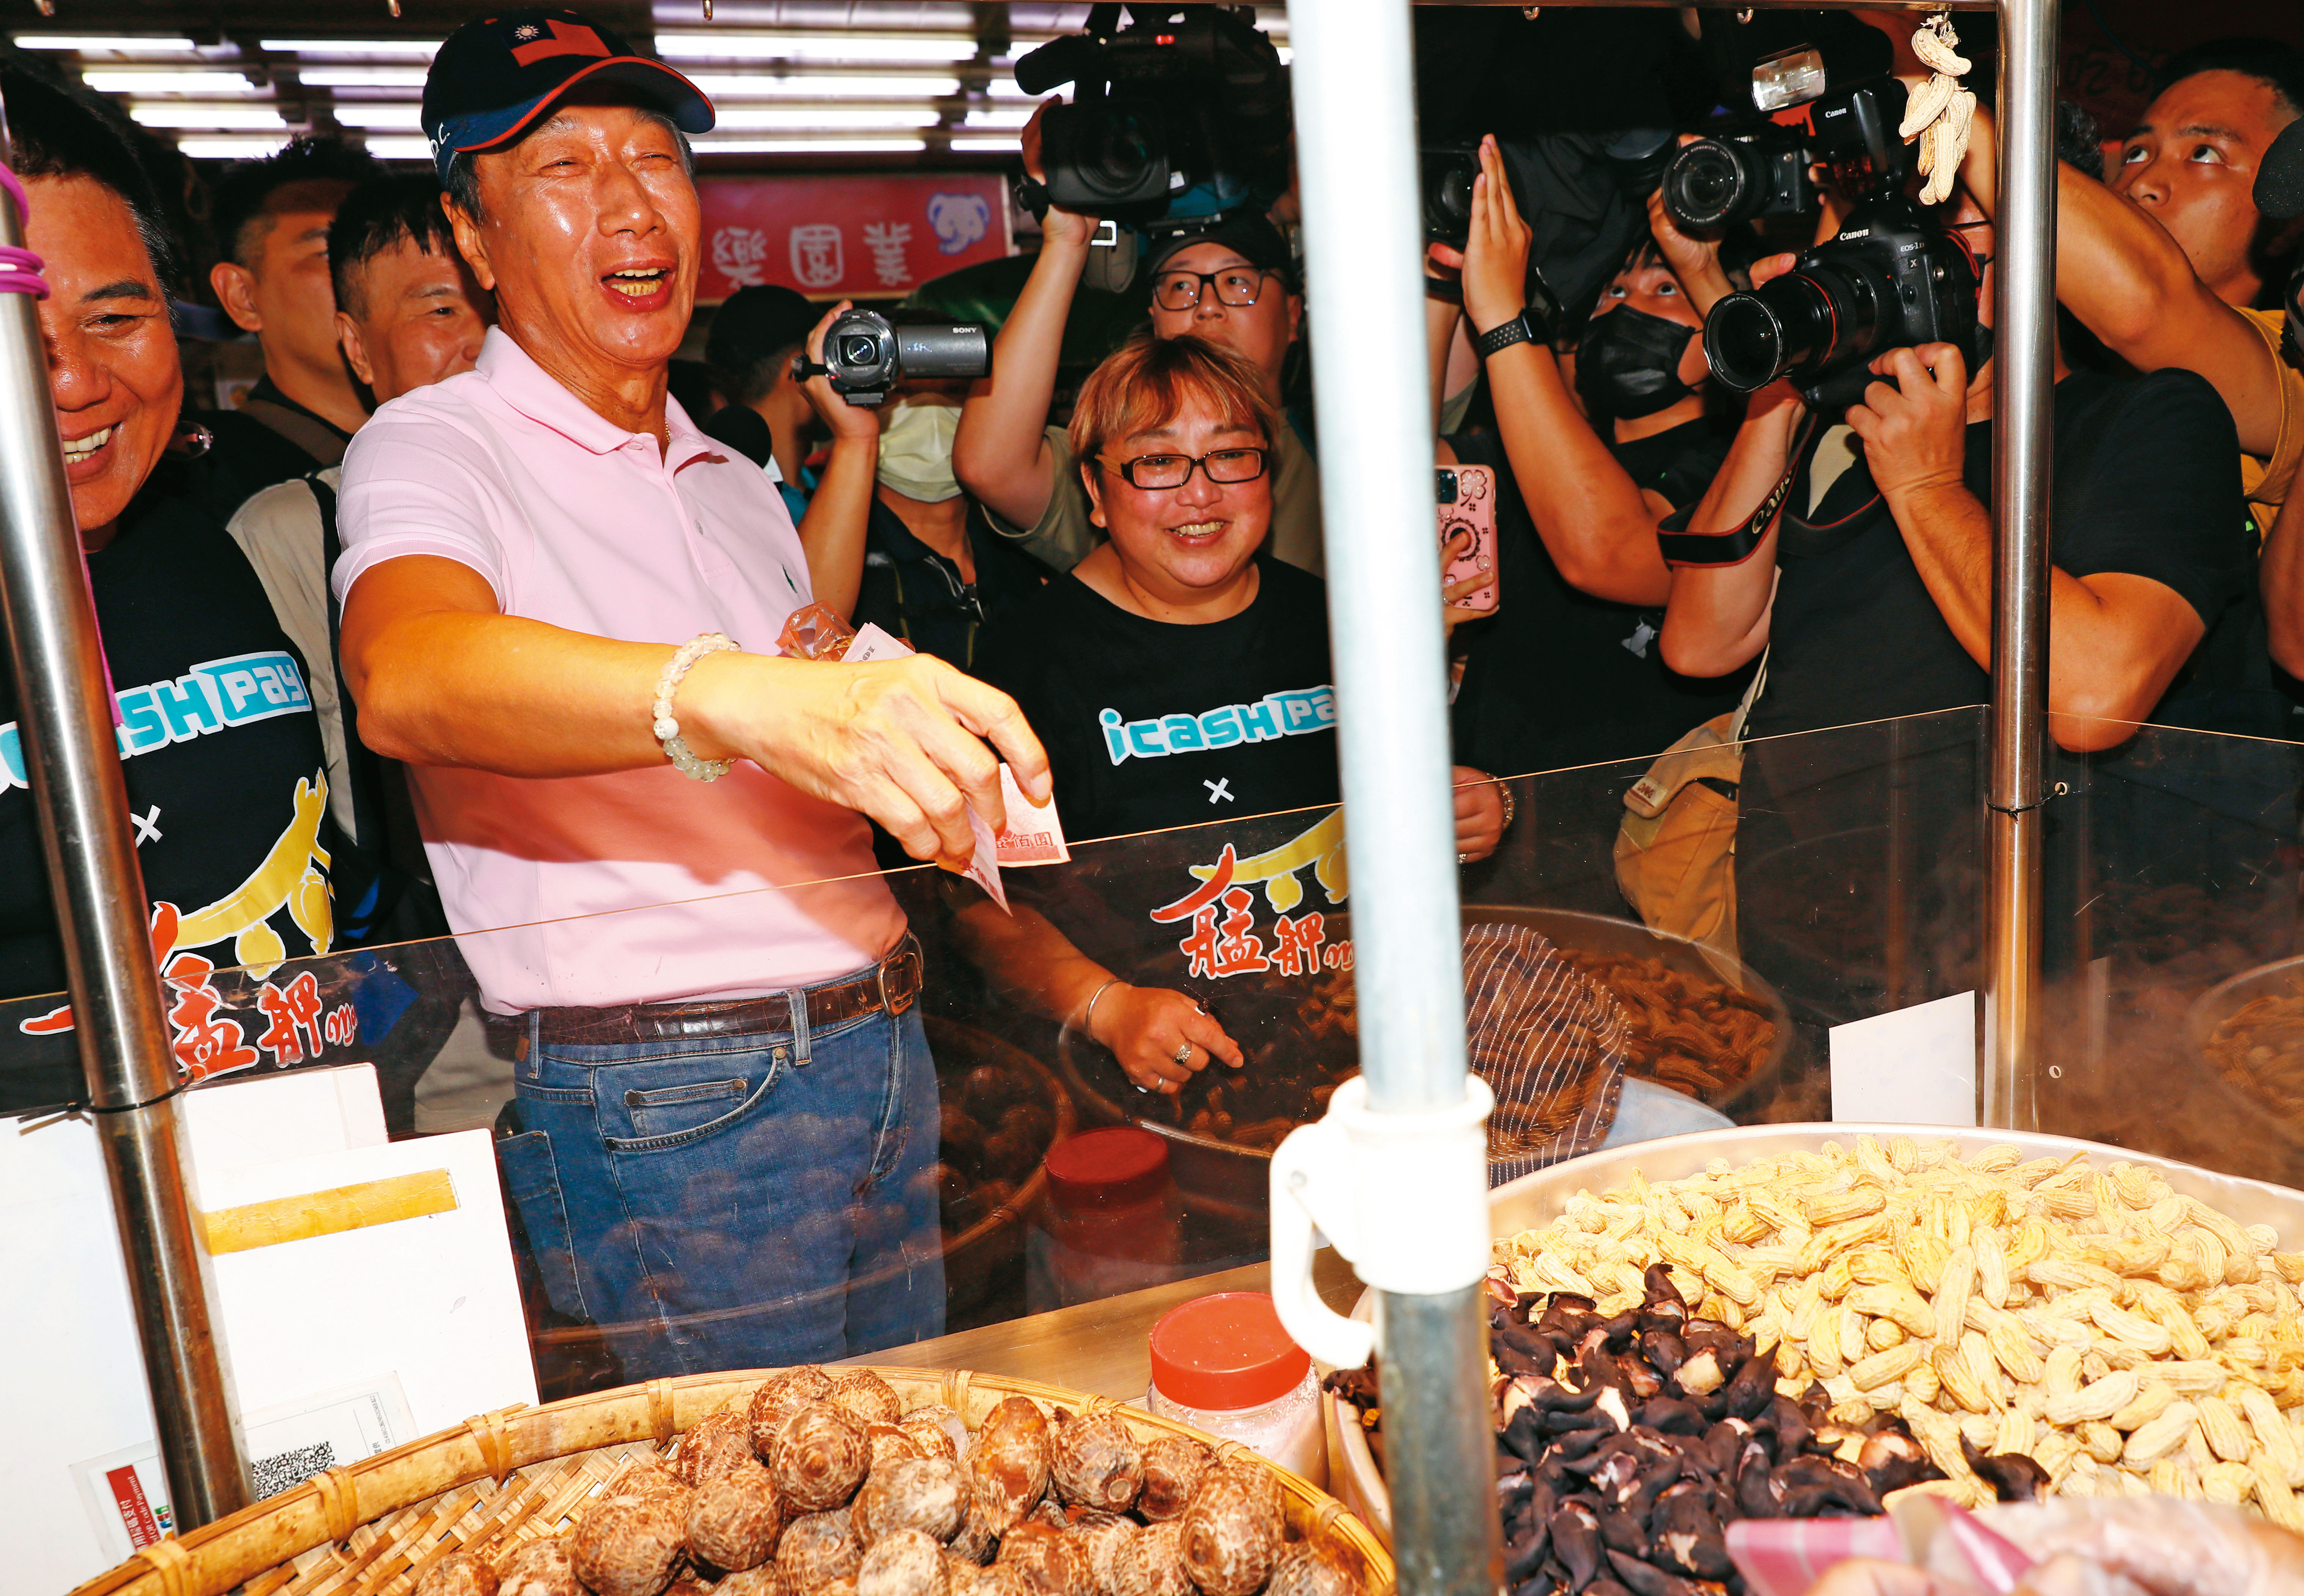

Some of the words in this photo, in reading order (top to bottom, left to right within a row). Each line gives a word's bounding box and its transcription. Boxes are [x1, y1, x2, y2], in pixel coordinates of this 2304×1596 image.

[1825, 107, 1847, 118] Canon
[1839, 228, 1869, 241] Canon
[1910, 259, 1917, 268] X
[127, 1475, 145, 1506] Payment
[139, 1505, 152, 1524] Code
[146, 1523, 157, 1536] QR
